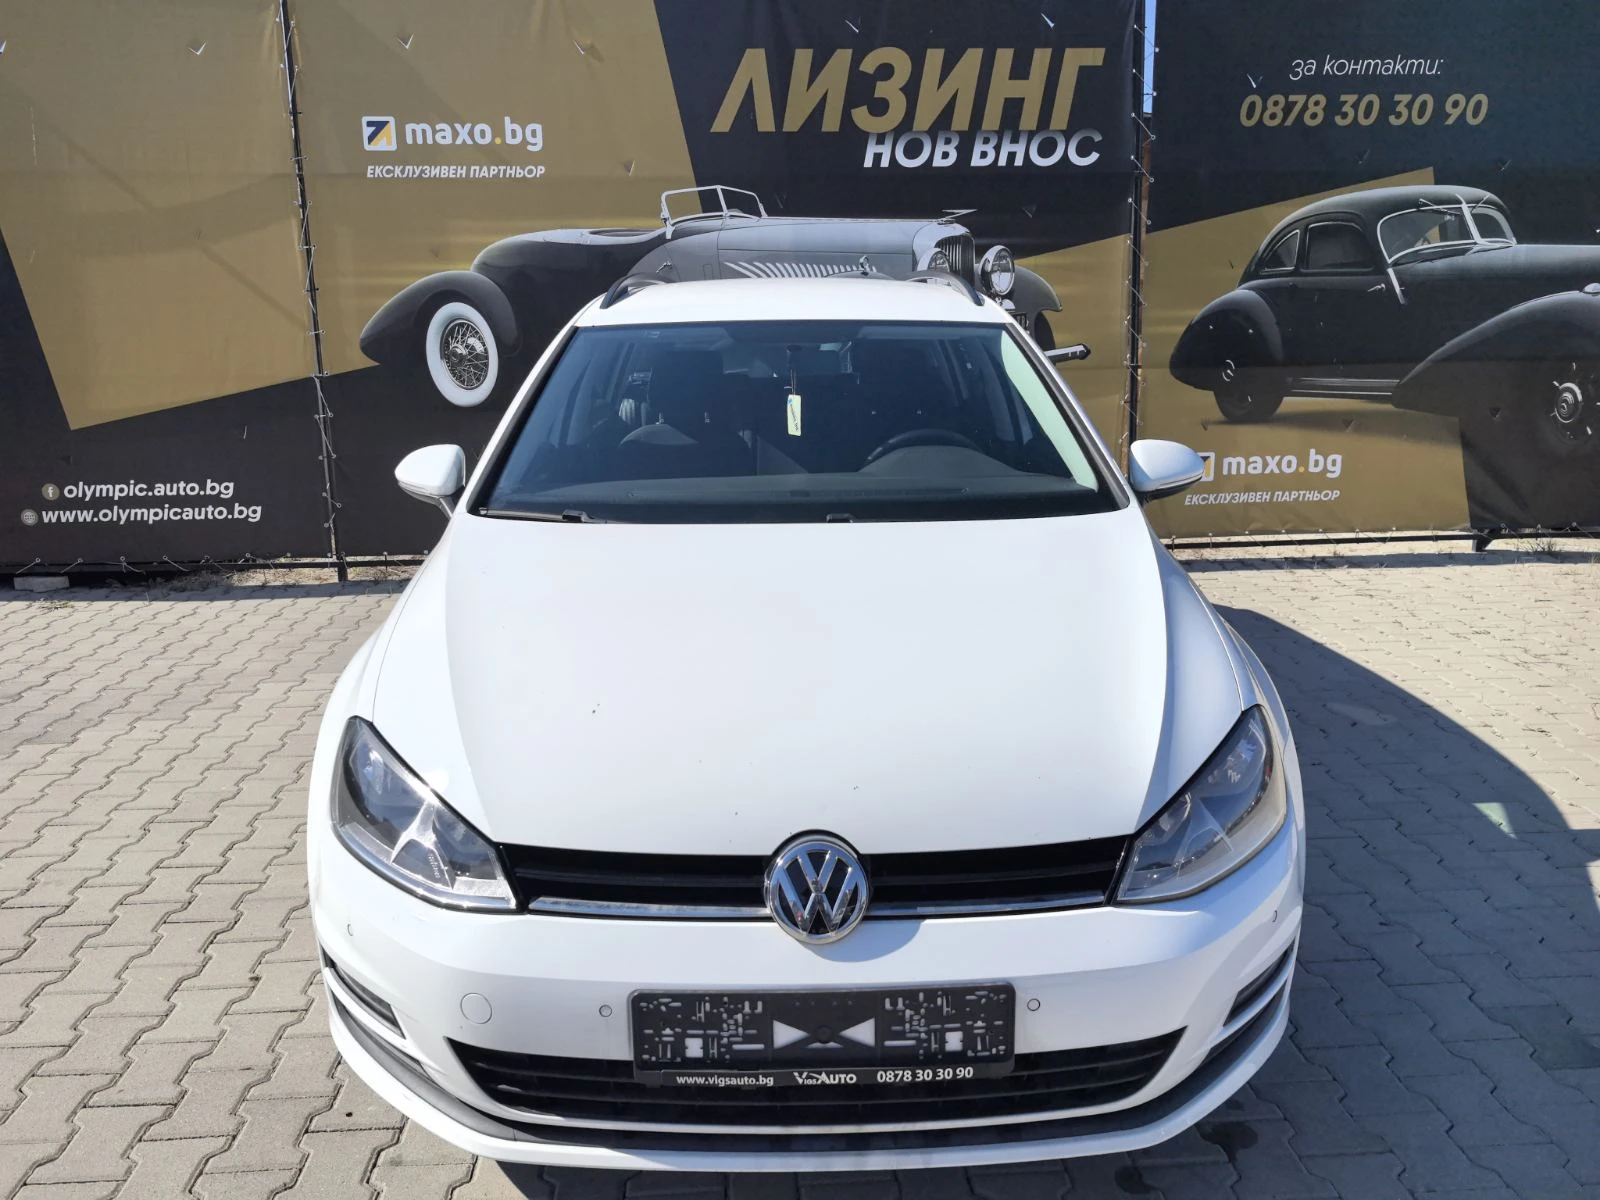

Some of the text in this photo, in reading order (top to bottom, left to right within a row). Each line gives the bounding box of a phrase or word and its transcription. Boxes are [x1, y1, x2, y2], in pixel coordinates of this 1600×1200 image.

[1289, 54, 1444, 80] за контакти:
[710, 46, 1106, 133] ЛИЗИНГ
[1239, 93, 1489, 127] 0878 30 30 90
[404, 116, 544, 152] maxo.bg
[863, 129, 1103, 168] НОВ ВНОС
[366, 165, 546, 179] ЕКСКЛУЗИВЕН ПАРТНЬОР
[1222, 448, 1343, 479] maxo.bg
[63, 479, 234, 500] olympic.auto.bg
[1184, 490, 1341, 506] ЕКСКЛУЗИВЕН ПАРТНЬОР
[42, 503, 262, 524] www.olympicauto.bg
[676, 1074, 774, 1087] www.vigsauto.bg
[876, 1070, 913, 1083] 0878
[915, 1070, 933, 1081] 30
[935, 1068, 954, 1080] 30
[956, 1067, 974, 1079] 90
